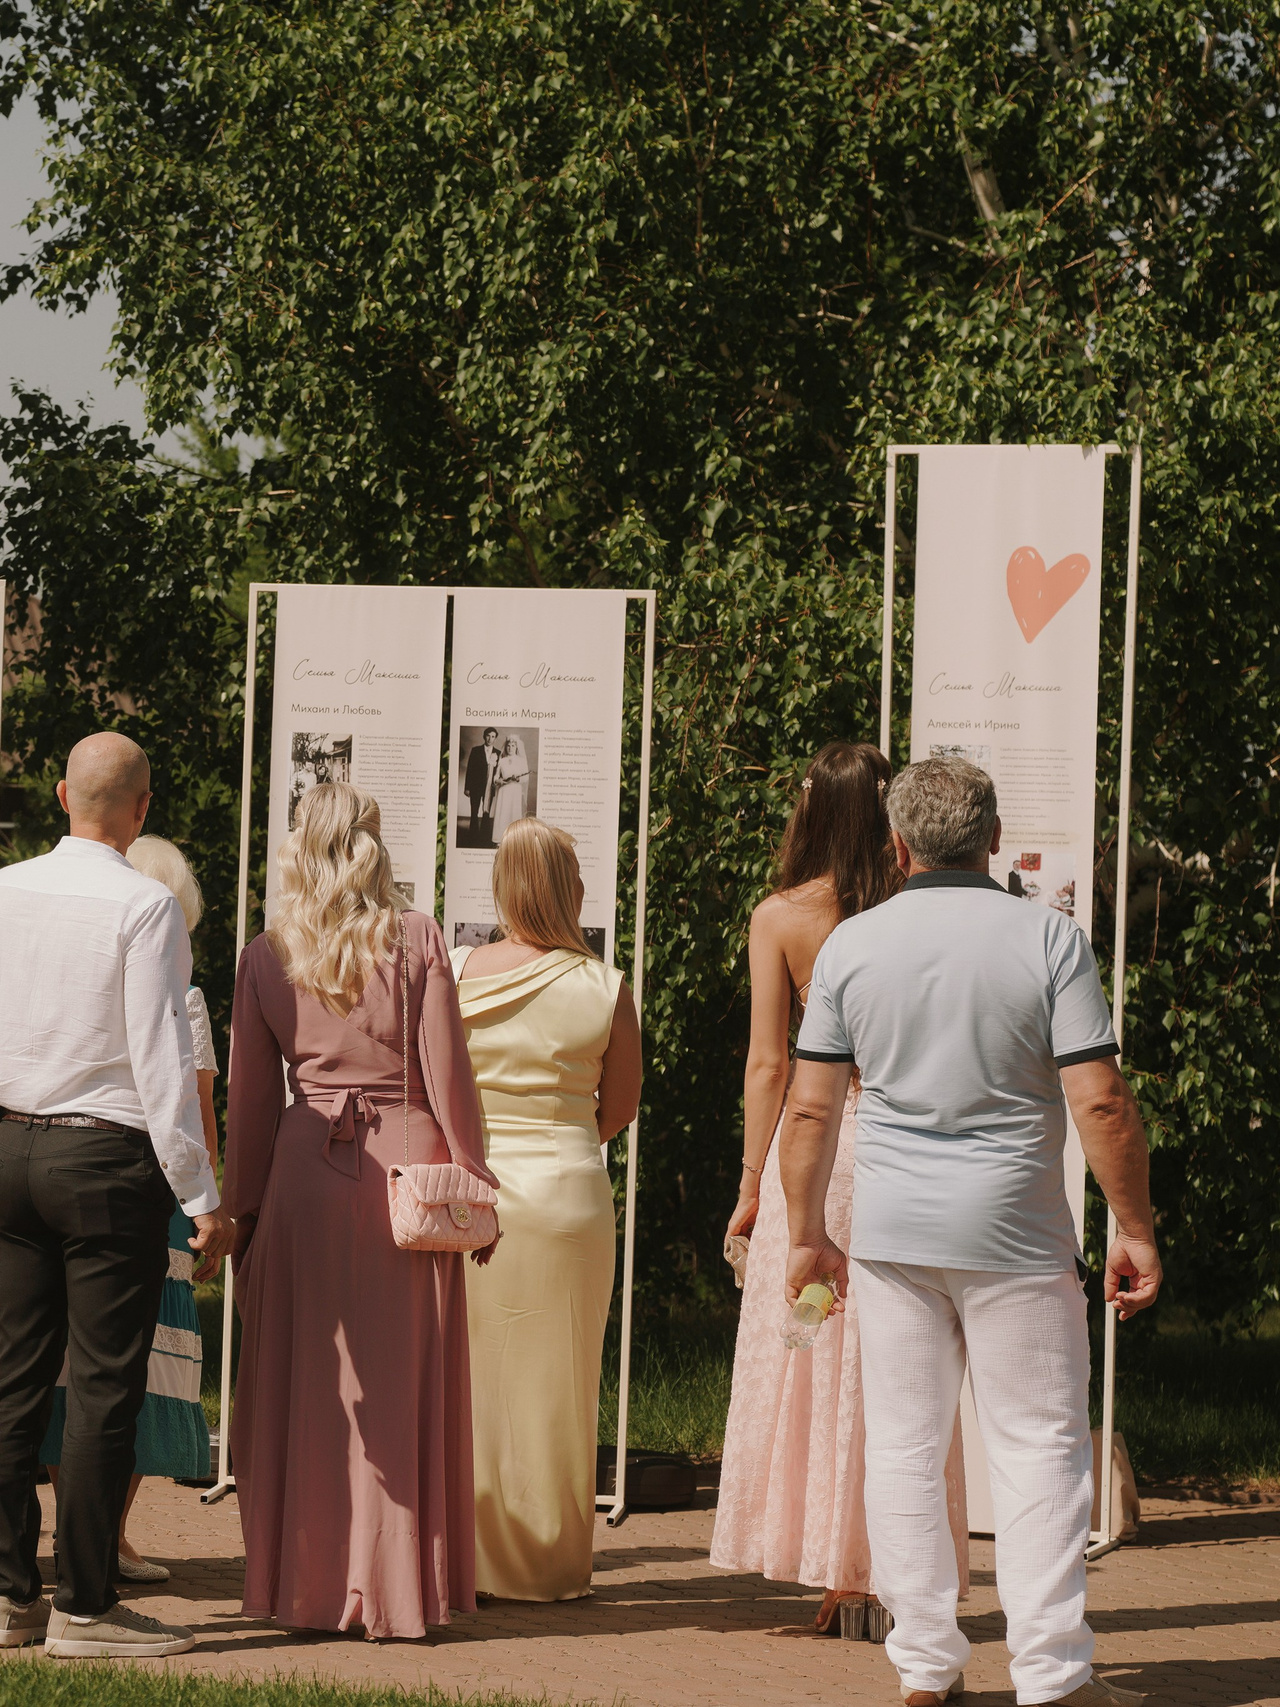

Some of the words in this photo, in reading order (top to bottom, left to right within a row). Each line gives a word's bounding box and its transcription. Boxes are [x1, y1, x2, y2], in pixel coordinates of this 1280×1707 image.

[293, 659, 335, 680] Семья
[345, 659, 420, 685] Максима
[467, 662, 510, 684] Семья
[519, 662, 596, 688] Максима
[929, 672, 973, 695] Семья
[983, 672, 1062, 698] Максима
[291, 704, 330, 714] Михаил
[342, 705, 381, 715] Любовь
[466, 707, 508, 718] Василий
[521, 709, 556, 720] Мария
[927, 719, 971, 729] Алексей
[985, 720, 1020, 732] Ирина
